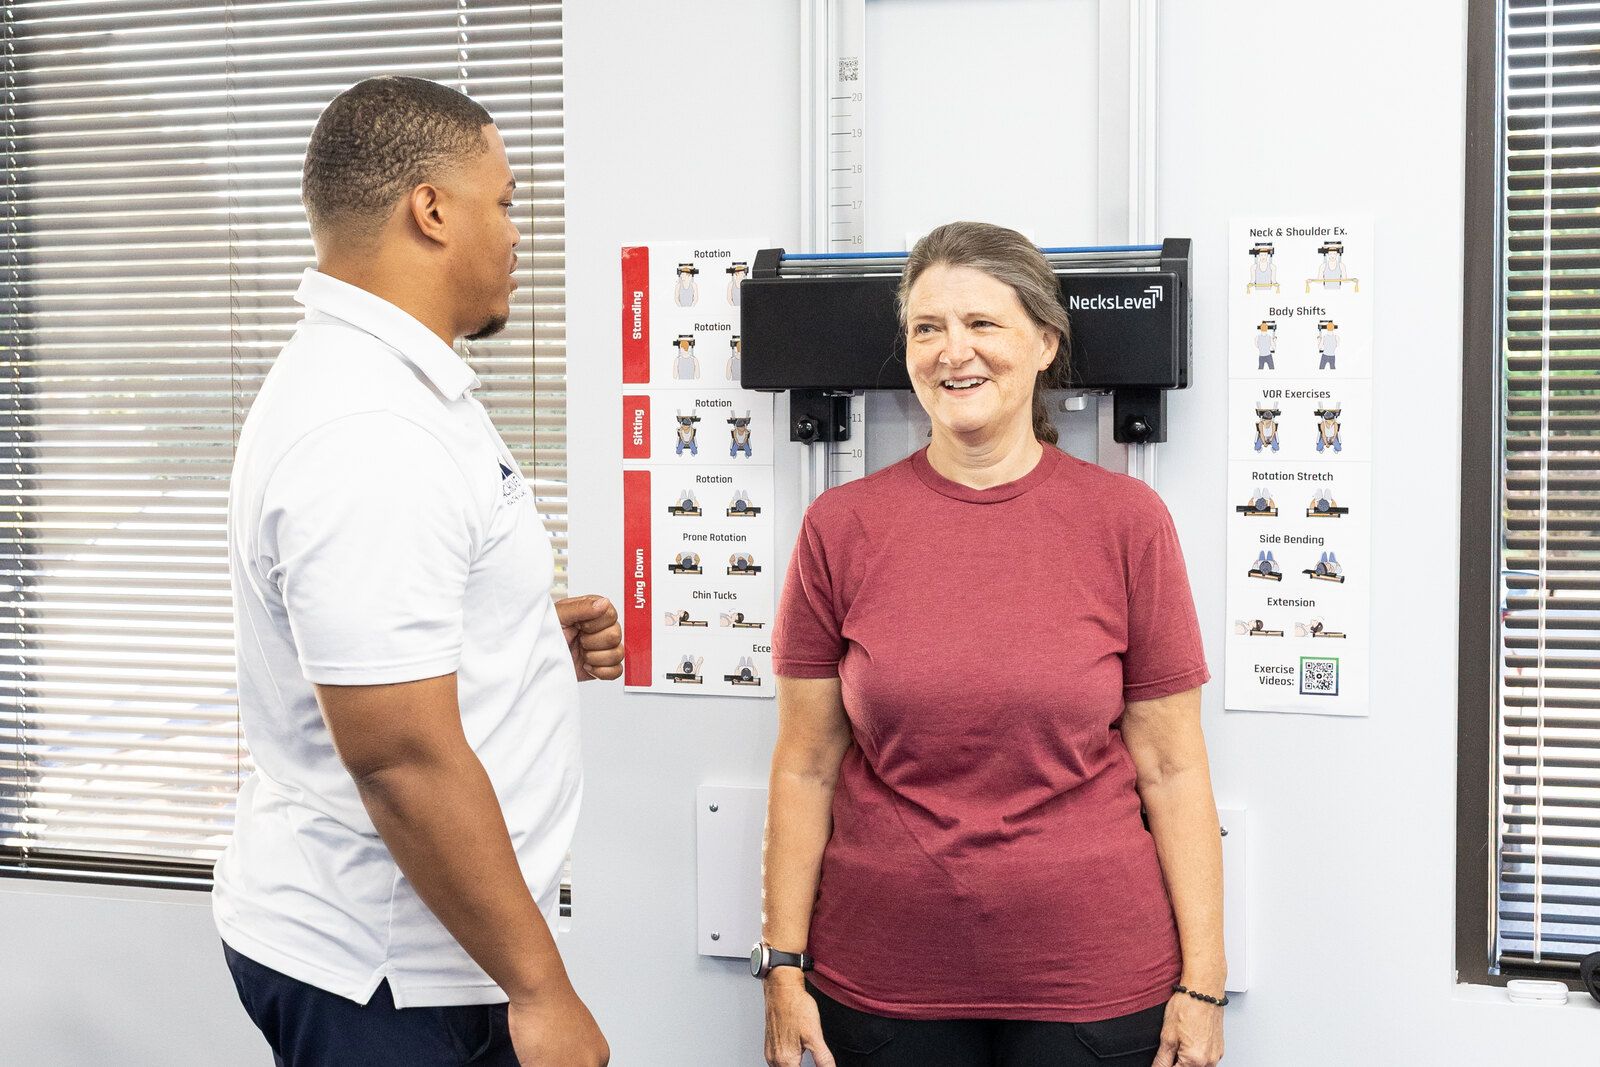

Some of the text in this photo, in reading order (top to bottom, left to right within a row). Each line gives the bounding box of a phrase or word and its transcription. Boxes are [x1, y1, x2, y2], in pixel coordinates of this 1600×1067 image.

[851, 92, 863, 102] 20
[851, 127, 863, 138] 19
[851, 162, 863, 174] 18
[851, 200, 863, 210] 17
[1249, 227, 1348, 237] Neck & Shoulder Ex.
[851, 234, 863, 245] 16
[694, 249, 731, 259] Rotation
[1069, 294, 1157, 310] NecksLevel
[631, 291, 644, 340] Standing
[1269, 307, 1326, 318] Body Shifts
[694, 323, 732, 332] Rotation
[1262, 389, 1331, 399] VOR Exercises
[695, 399, 733, 408] Rotation
[852, 413, 863, 423] 11
[632, 410, 645, 446] Sitting
[852, 448, 863, 459] 10
[695, 475, 733, 484] Rotation
[1252, 472, 1334, 481] Rotation Stretch
[682, 533, 747, 542] Prone Rotation
[1259, 534, 1325, 546] Side Bending
[633, 549, 646, 609] Lying Down
[692, 591, 738, 600] Chin Tucks
[1267, 598, 1316, 608] Extension
[1254, 664, 1295, 675] Exercise
[1258, 676, 1295, 686] Videos:
